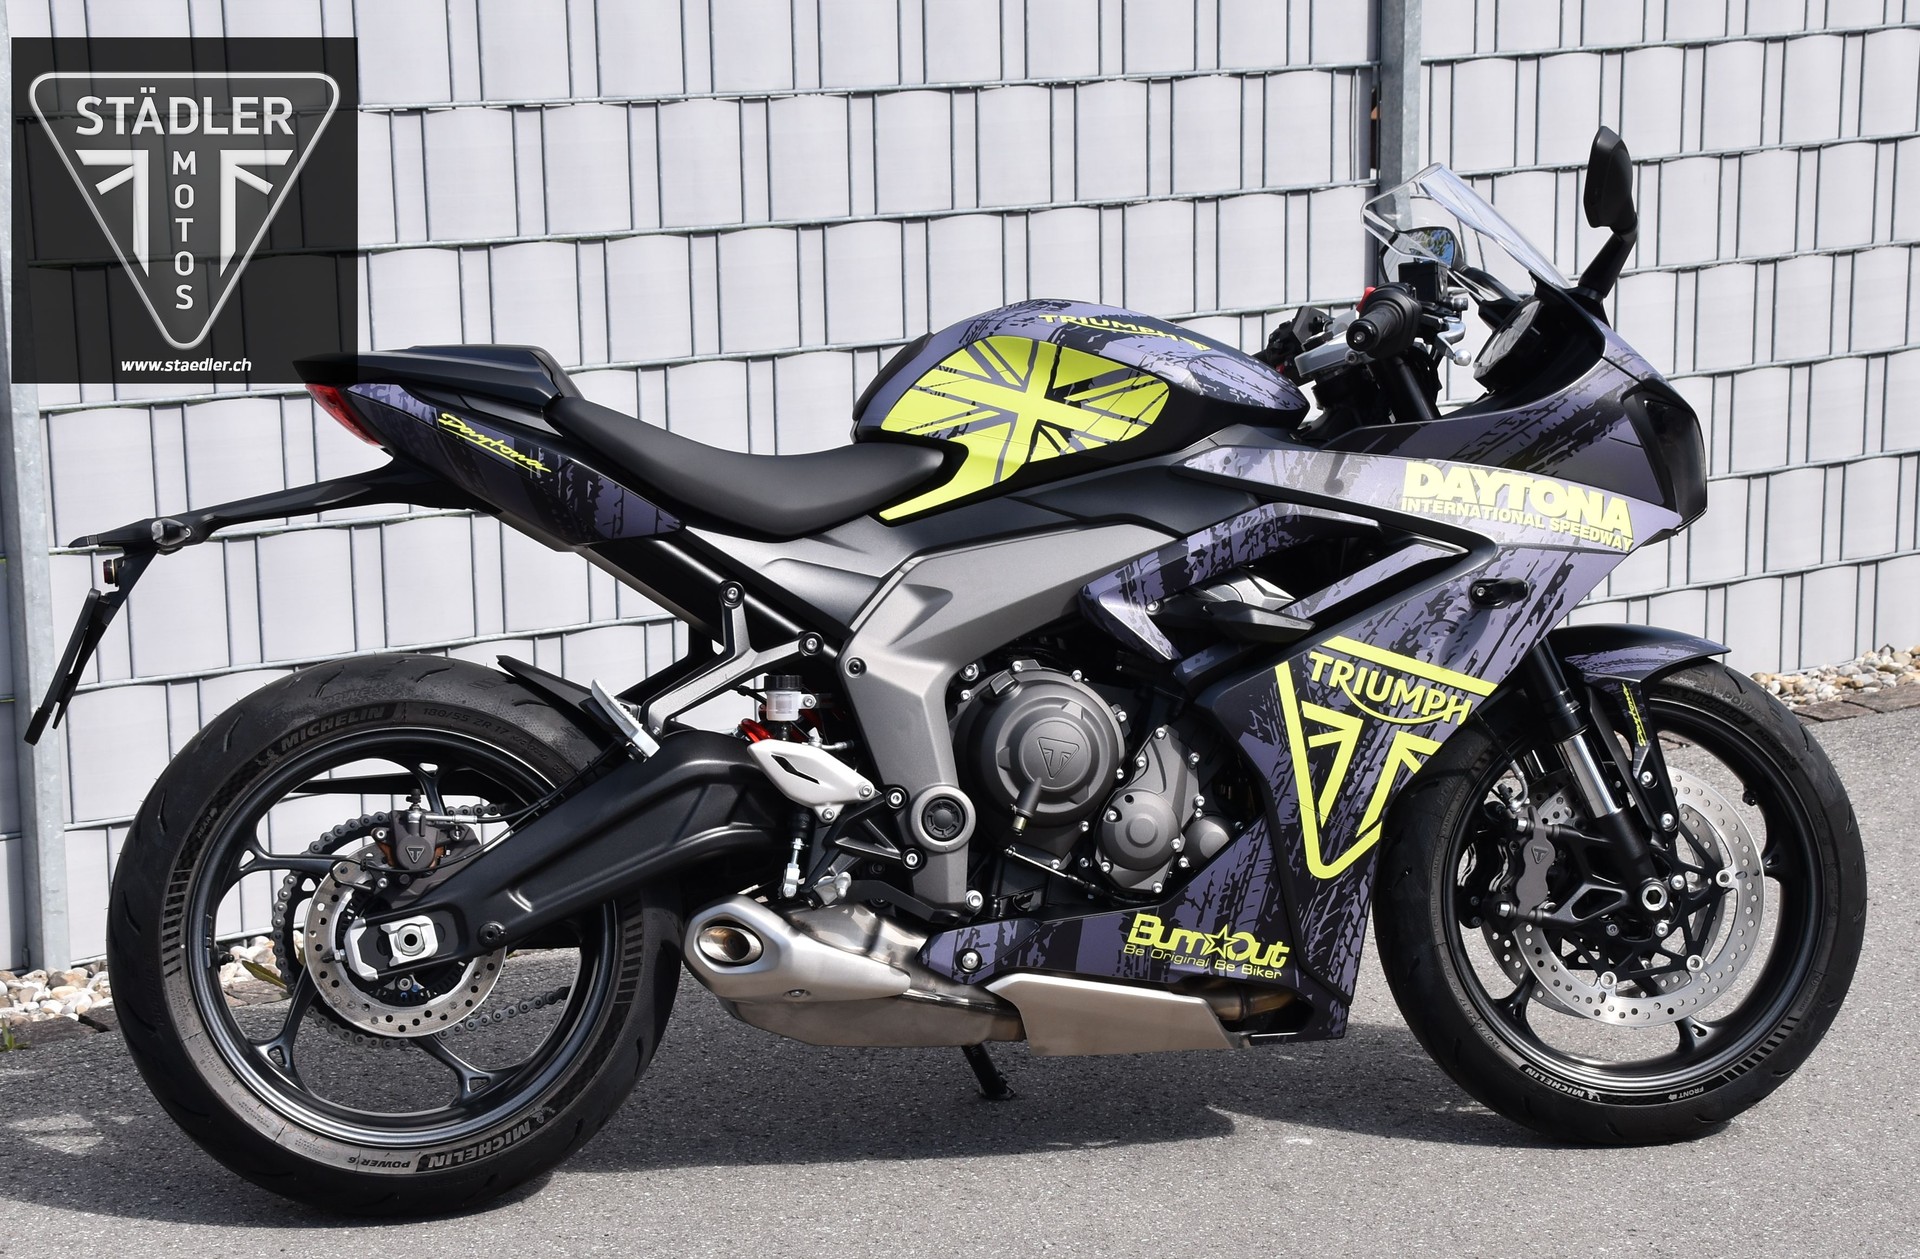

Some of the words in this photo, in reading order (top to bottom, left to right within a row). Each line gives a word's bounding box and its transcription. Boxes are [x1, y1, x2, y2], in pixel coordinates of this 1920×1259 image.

[1038, 314, 1181, 342] TRIUMPH
[437, 412, 552, 473] Daytona
[1402, 461, 1634, 539] DAYTONA
[1401, 498, 1546, 530] INTERNATIONAL
[1549, 517, 1634, 552] SPEEDWAY
[1309, 651, 1473, 725] TRIUMPH
[280, 706, 385, 751] MICHELIN
[423, 707, 470, 723] 180/55
[473, 718, 492, 729] ZR
[495, 724, 510, 736] 17
[1124, 944, 1144, 956] Be
[1150, 948, 1209, 968] Original
[1214, 959, 1236, 972] Be
[1241, 964, 1282, 980] Biker
[1525, 1067, 1585, 1098] MICHELIN
[1678, 1086, 1705, 1099] FRONT
[360, 1158, 411, 1169] POWER
[427, 1120, 531, 1169] MICHELIN
